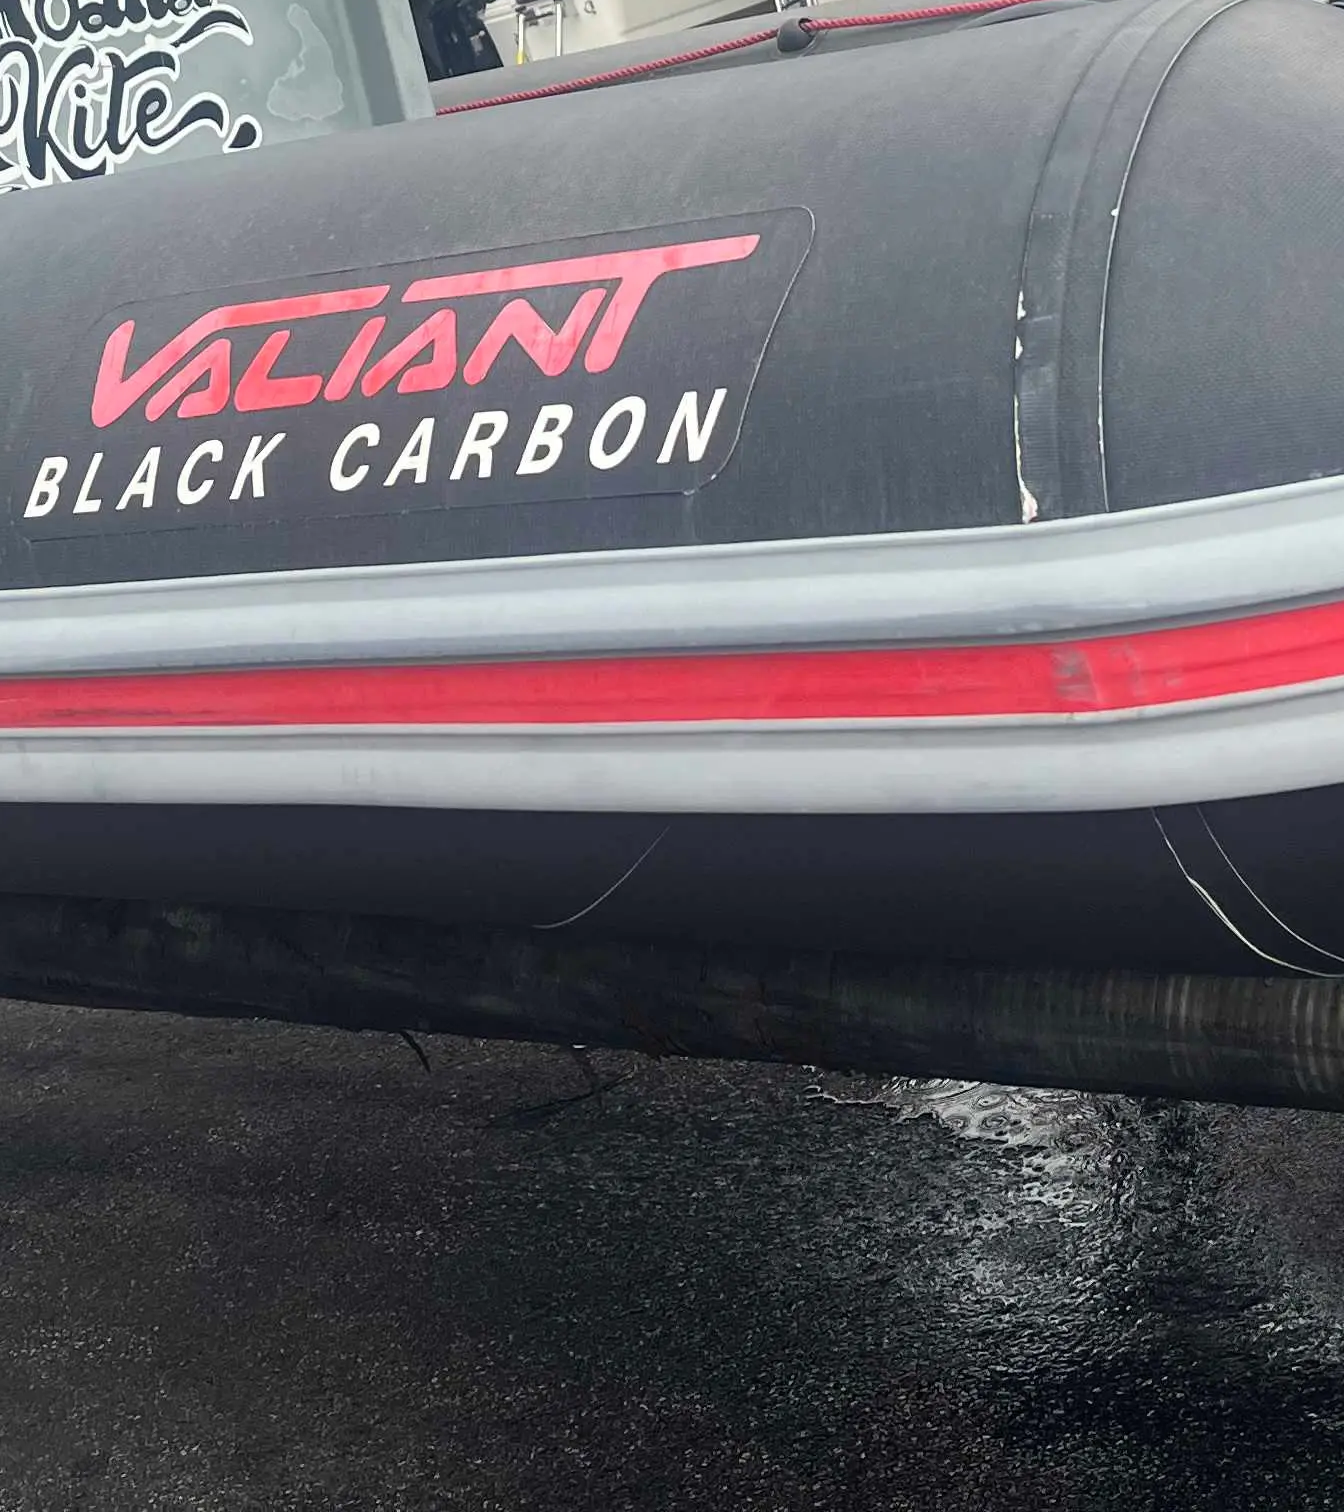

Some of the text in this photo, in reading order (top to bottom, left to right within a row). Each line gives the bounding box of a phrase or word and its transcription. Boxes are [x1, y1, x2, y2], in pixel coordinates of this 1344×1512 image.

[90, 233, 761, 428] VALIANT
[23, 387, 728, 519] BLACK CARBON
